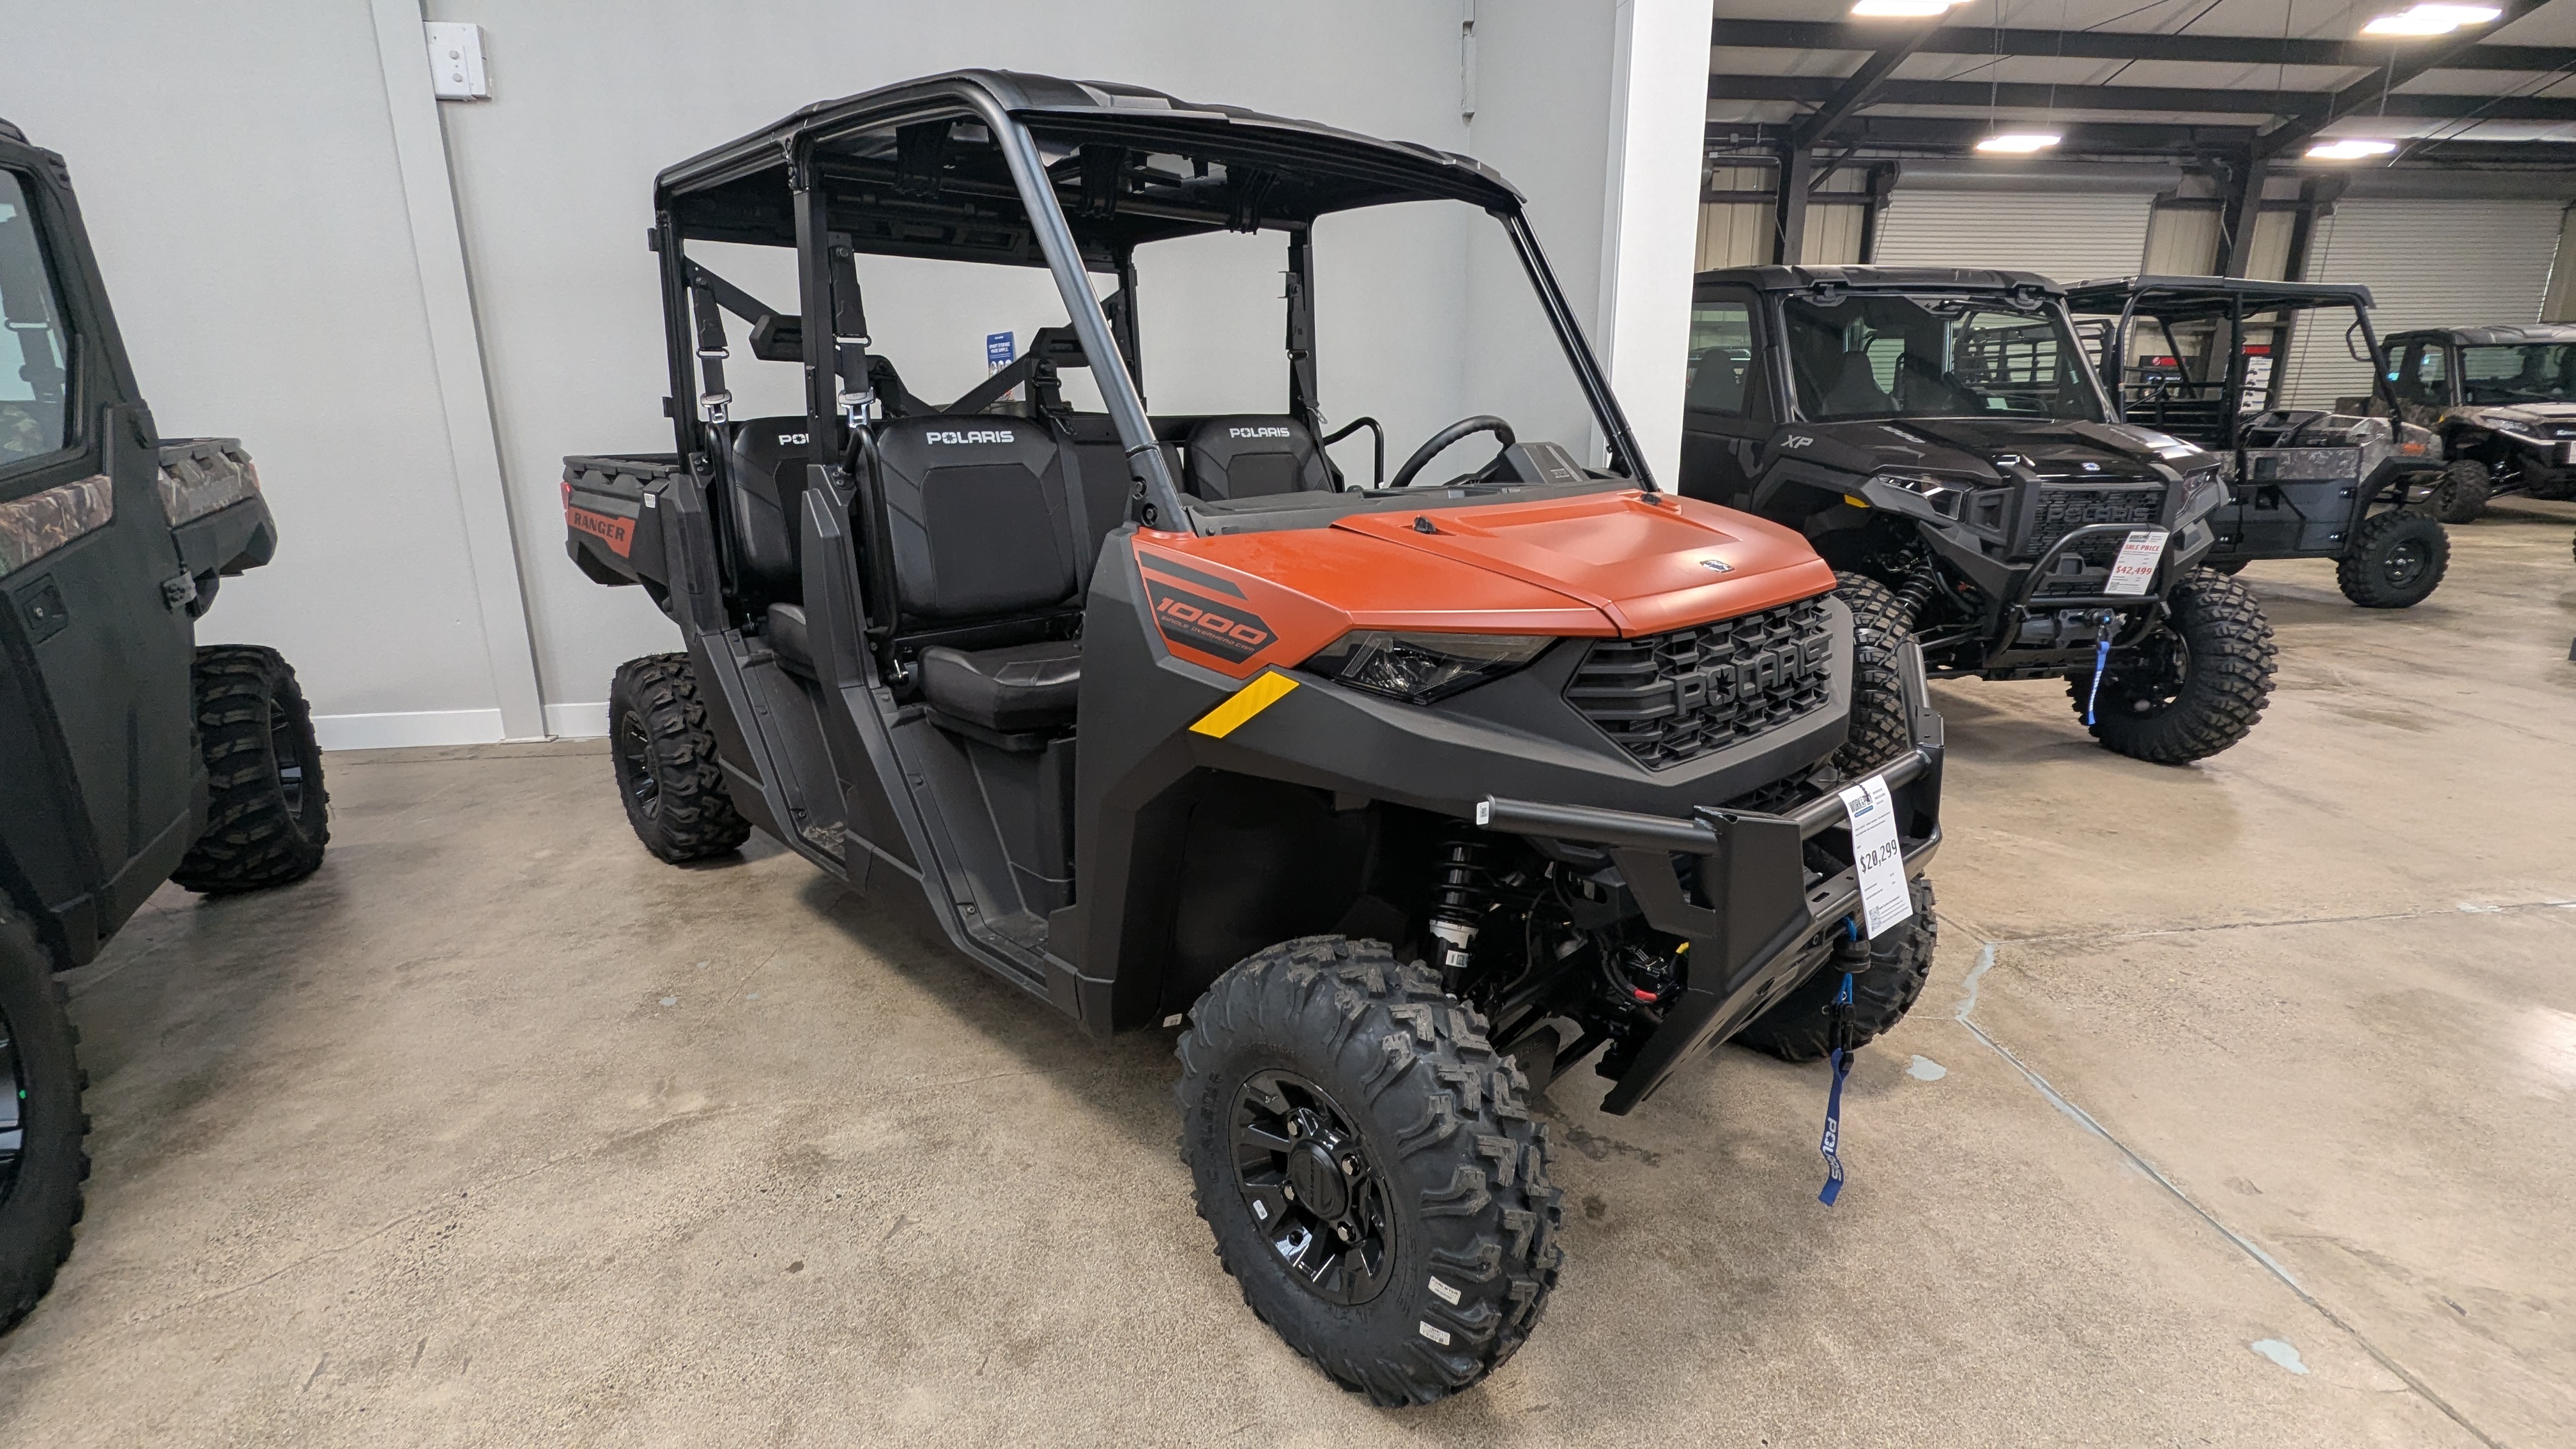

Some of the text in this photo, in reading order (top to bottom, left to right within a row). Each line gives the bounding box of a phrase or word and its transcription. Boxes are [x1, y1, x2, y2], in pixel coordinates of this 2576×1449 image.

[926, 431, 1015, 445] POLARIS
[1229, 427, 1290, 438] POLARIS
[1781, 434, 1813, 448] XP
[574, 513, 625, 542] RANGER
[2046, 507, 2148, 523] POLARIS
[2115, 565, 2152, 575] $42,499
[1157, 597, 1268, 645] 1000
[1161, 616, 1189, 629] SINGLE
[1191, 626, 1234, 645] OVERHEAD
[1675, 635, 1831, 716] POLARIS
[1860, 839, 1897, 874] $20,299
[1823, 1117, 1841, 1181] POLARIS
